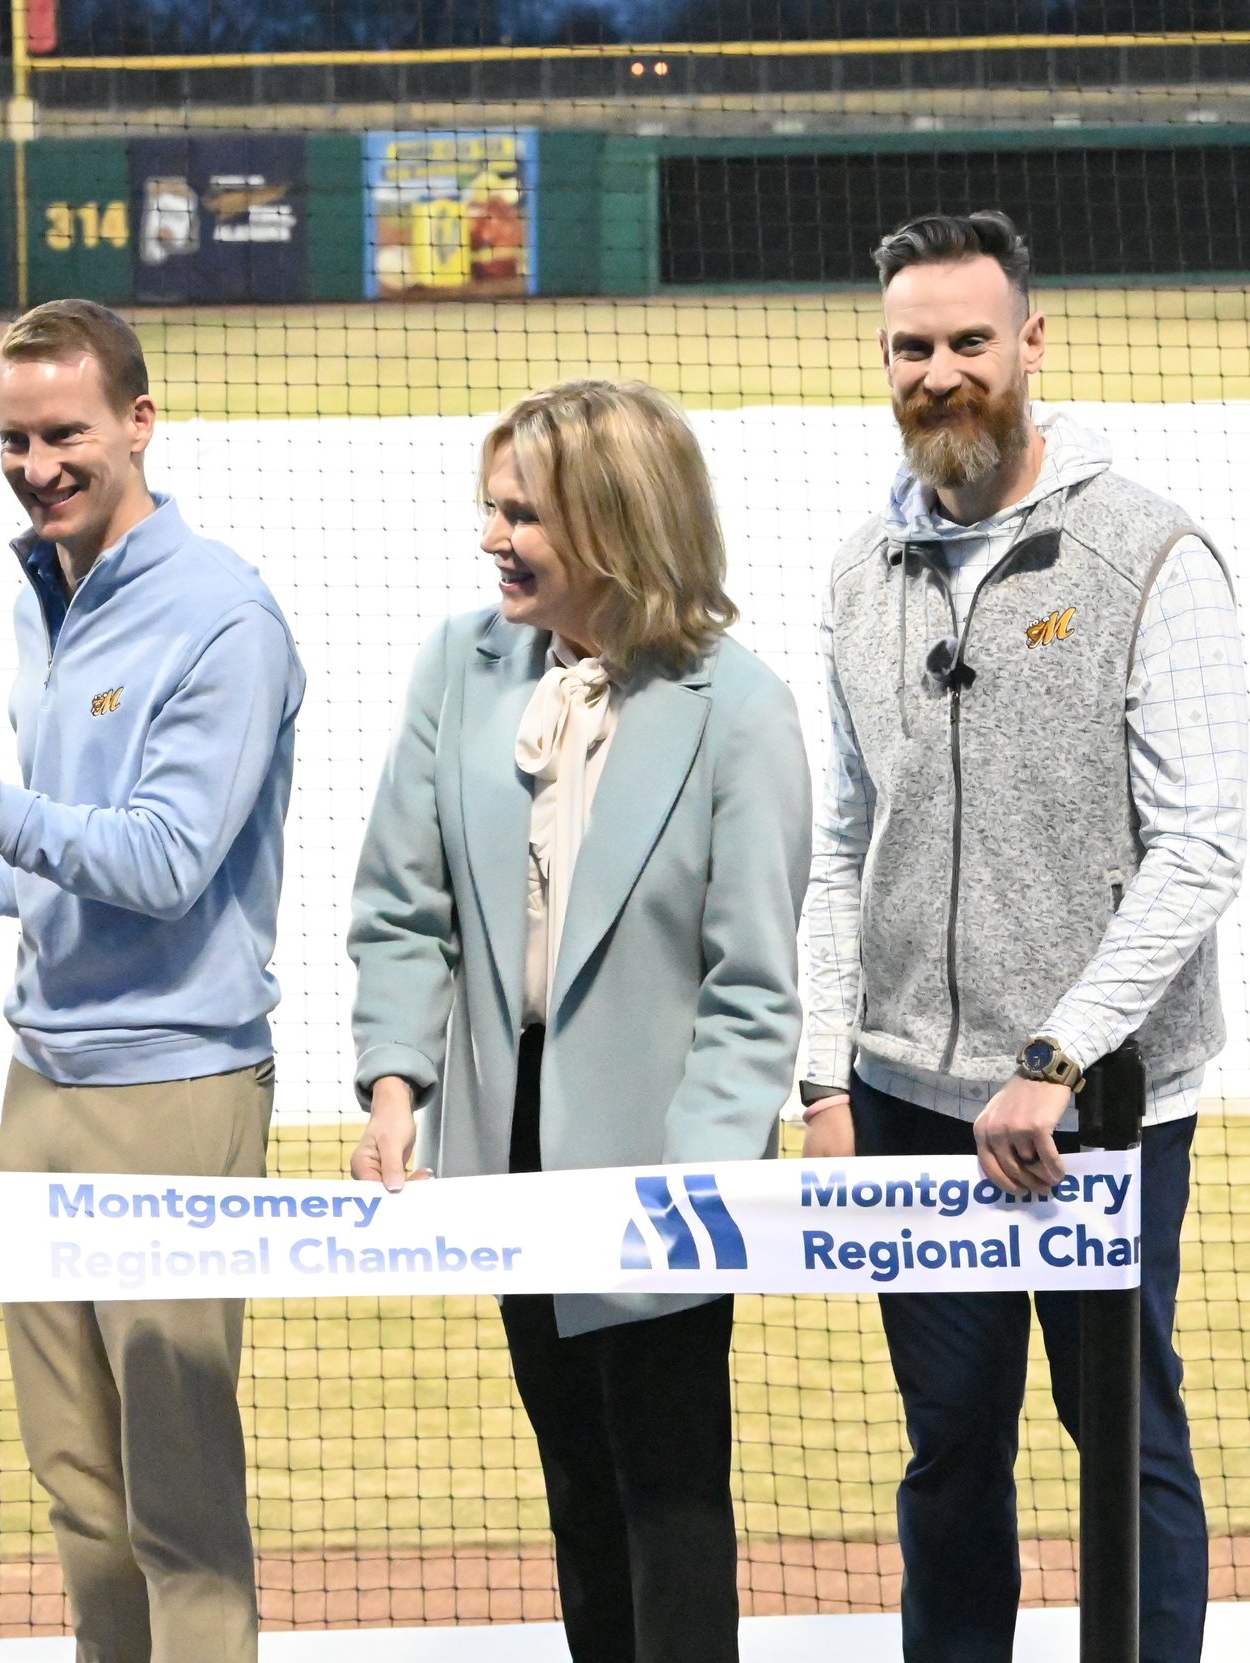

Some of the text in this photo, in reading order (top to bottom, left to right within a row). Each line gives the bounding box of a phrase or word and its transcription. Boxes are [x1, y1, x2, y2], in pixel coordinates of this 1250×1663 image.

[45, 201, 129, 250] 314
[49, 1183, 382, 1228] Montgomery
[800, 1171, 1132, 1217] Montgoery
[50, 1236, 522, 1289] Regional Chamber
[803, 1225, 1020, 1282] Regional
